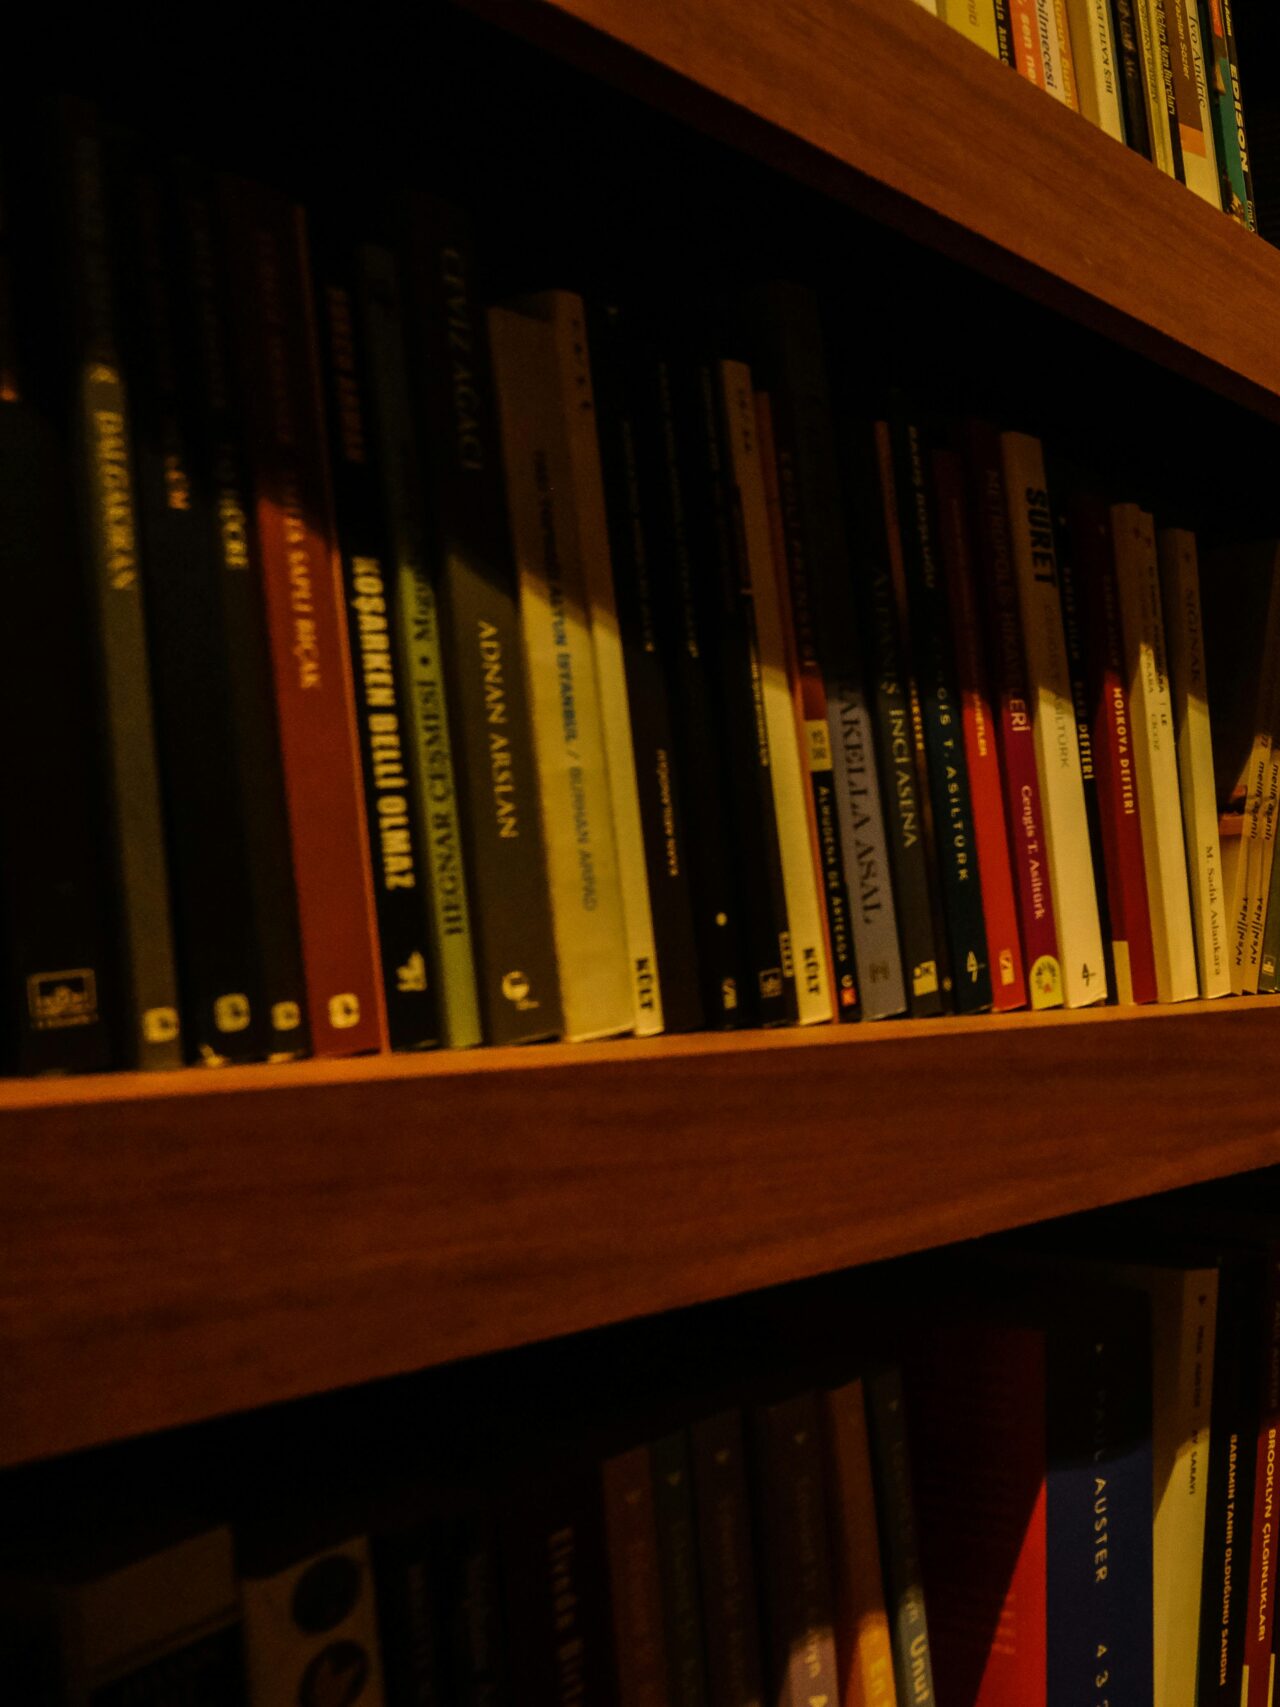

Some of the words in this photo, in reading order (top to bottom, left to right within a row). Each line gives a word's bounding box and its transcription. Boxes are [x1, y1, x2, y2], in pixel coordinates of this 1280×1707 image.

[1229, 63, 1249, 174] EDISON
[92, 409, 137, 591] DALGAKIRAN
[1025, 487, 1060, 588] SÜRET
[291, 618, 321, 689] BIÇAK
[351, 556, 397, 707] KOŞARKEN
[477, 620, 507, 723] ADNAN
[367, 712, 409, 788] BELLİ
[414, 679, 454, 806] ÇEŞMESİ
[888, 708, 914, 764] İNCİ
[1077, 724, 1095, 781] DEFTERİ
[1112, 687, 1130, 755] MOSKOVA
[487, 732, 520, 839] ARSLAN
[892, 771, 918, 849] ASENA
[1118, 758, 1136, 815] DEFTERİ
[375, 794, 417, 891] OLMAZ
[1204, 845, 1215, 865] M.
[826, 869, 841, 890] DE
[854, 840, 883, 924] ASAL
[1028, 859, 1047, 920] Asiltürk
[635, 957, 653, 1011] KÜLT
[803, 947, 821, 996] KÜLT
[1225, 1433, 1239, 1500] BABAMIN
[1263, 1427, 1278, 1519] BROOKLYN
[1093, 1477, 1110, 1583] AUSTER
[1224, 1502, 1236, 1545] TANRI
[1221, 1547, 1234, 1625] OLDUĞUNU
[1257, 1522, 1273, 1642] ÇILGINLIKLARI
[1095, 1643, 1108, 1659] 4
[1095, 1668, 1110, 1689] 3
[1218, 1627, 1230, 1687] SANDIM
